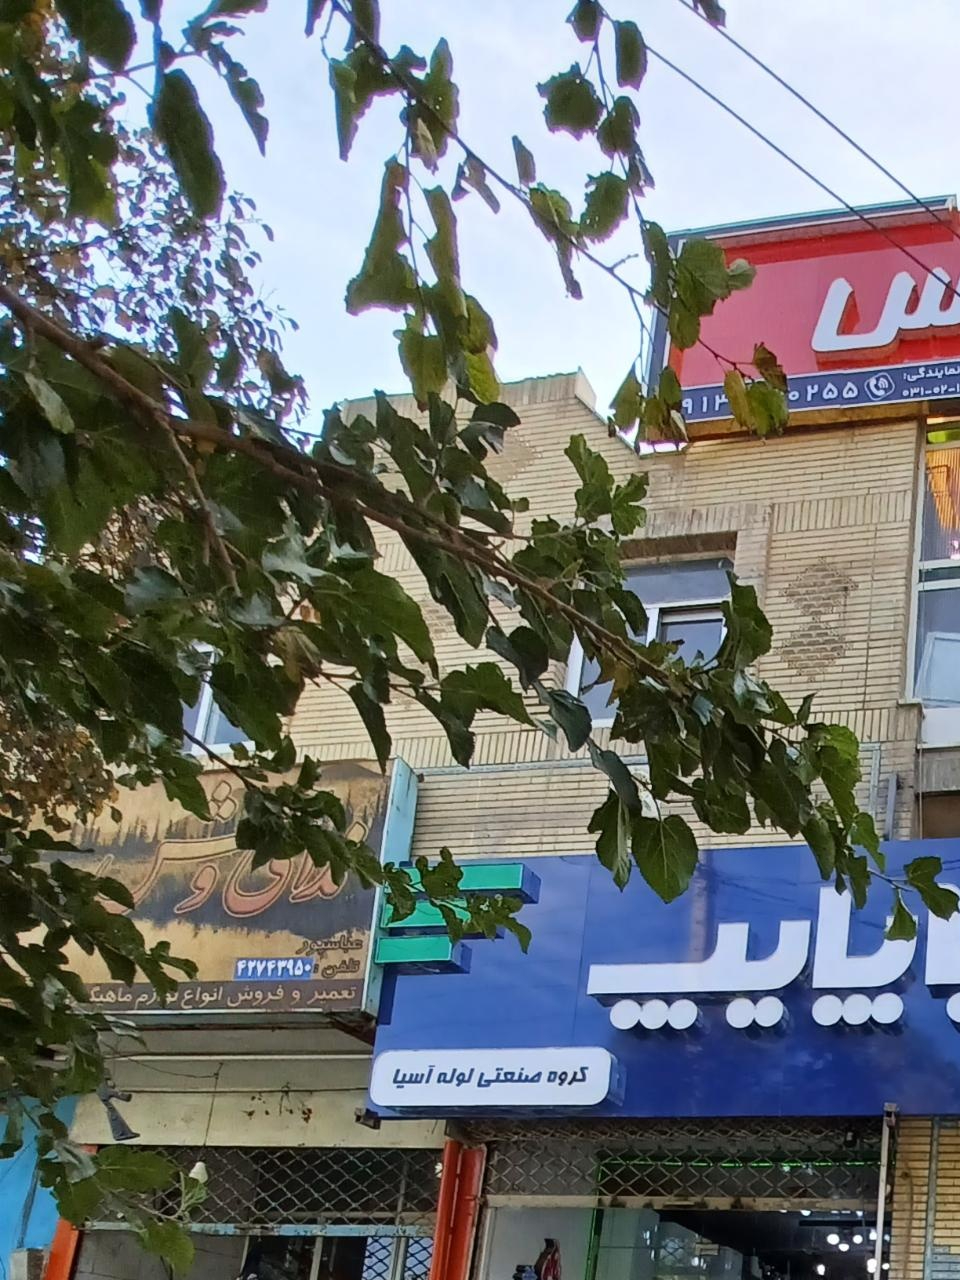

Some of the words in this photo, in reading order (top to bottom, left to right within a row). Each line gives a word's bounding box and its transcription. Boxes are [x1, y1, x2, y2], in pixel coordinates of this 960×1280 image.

[902, 365, 960, 382] نمایندگی:
[181, 986, 223, 1010] انواع
[226, 984, 285, 1008] فروش
[289, 989, 302, 1006] و
[306, 985, 357, 1006] تعمیر
[392, 1064, 436, 1090] آسیا
[436, 1067, 476, 1088] لوله
[476, 1067, 543, 1088] صنعتی
